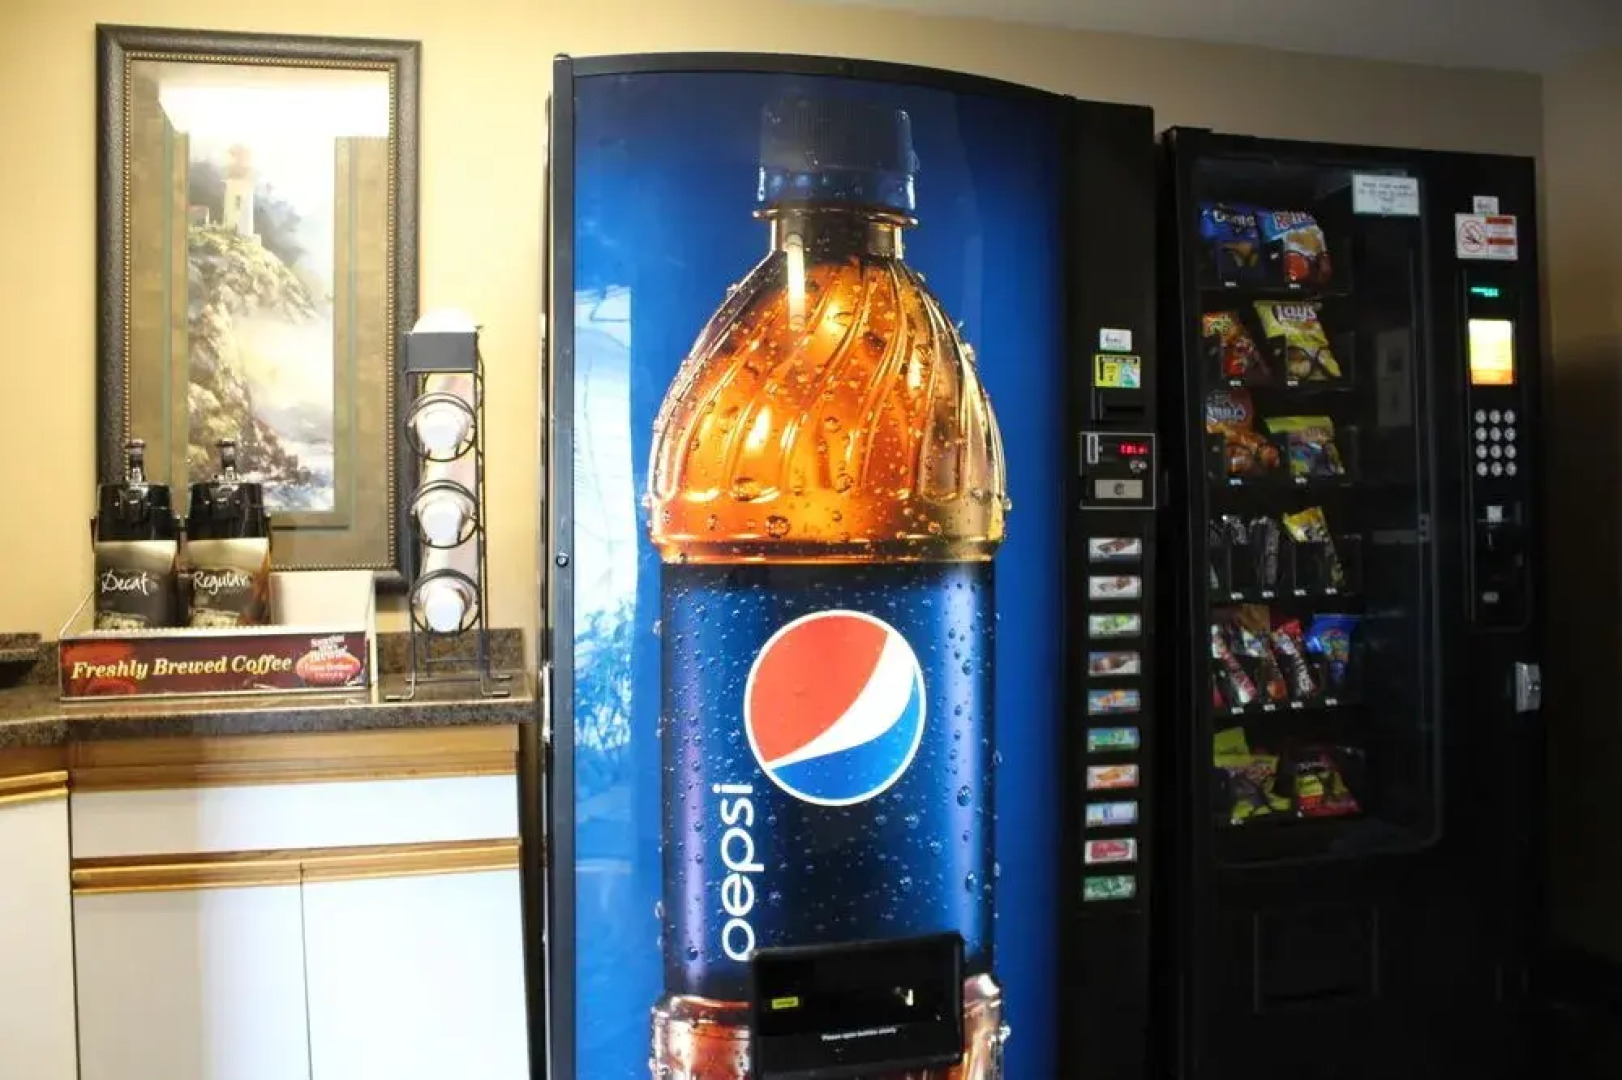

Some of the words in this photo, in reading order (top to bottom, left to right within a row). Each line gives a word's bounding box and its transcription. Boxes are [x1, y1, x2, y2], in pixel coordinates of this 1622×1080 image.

[100, 569, 149, 596] Decaf
[193, 570, 249, 596] Regular
[70, 659, 149, 681] Freshly
[152, 656, 228, 676] Brewed
[231, 653, 293, 676] Coffee
